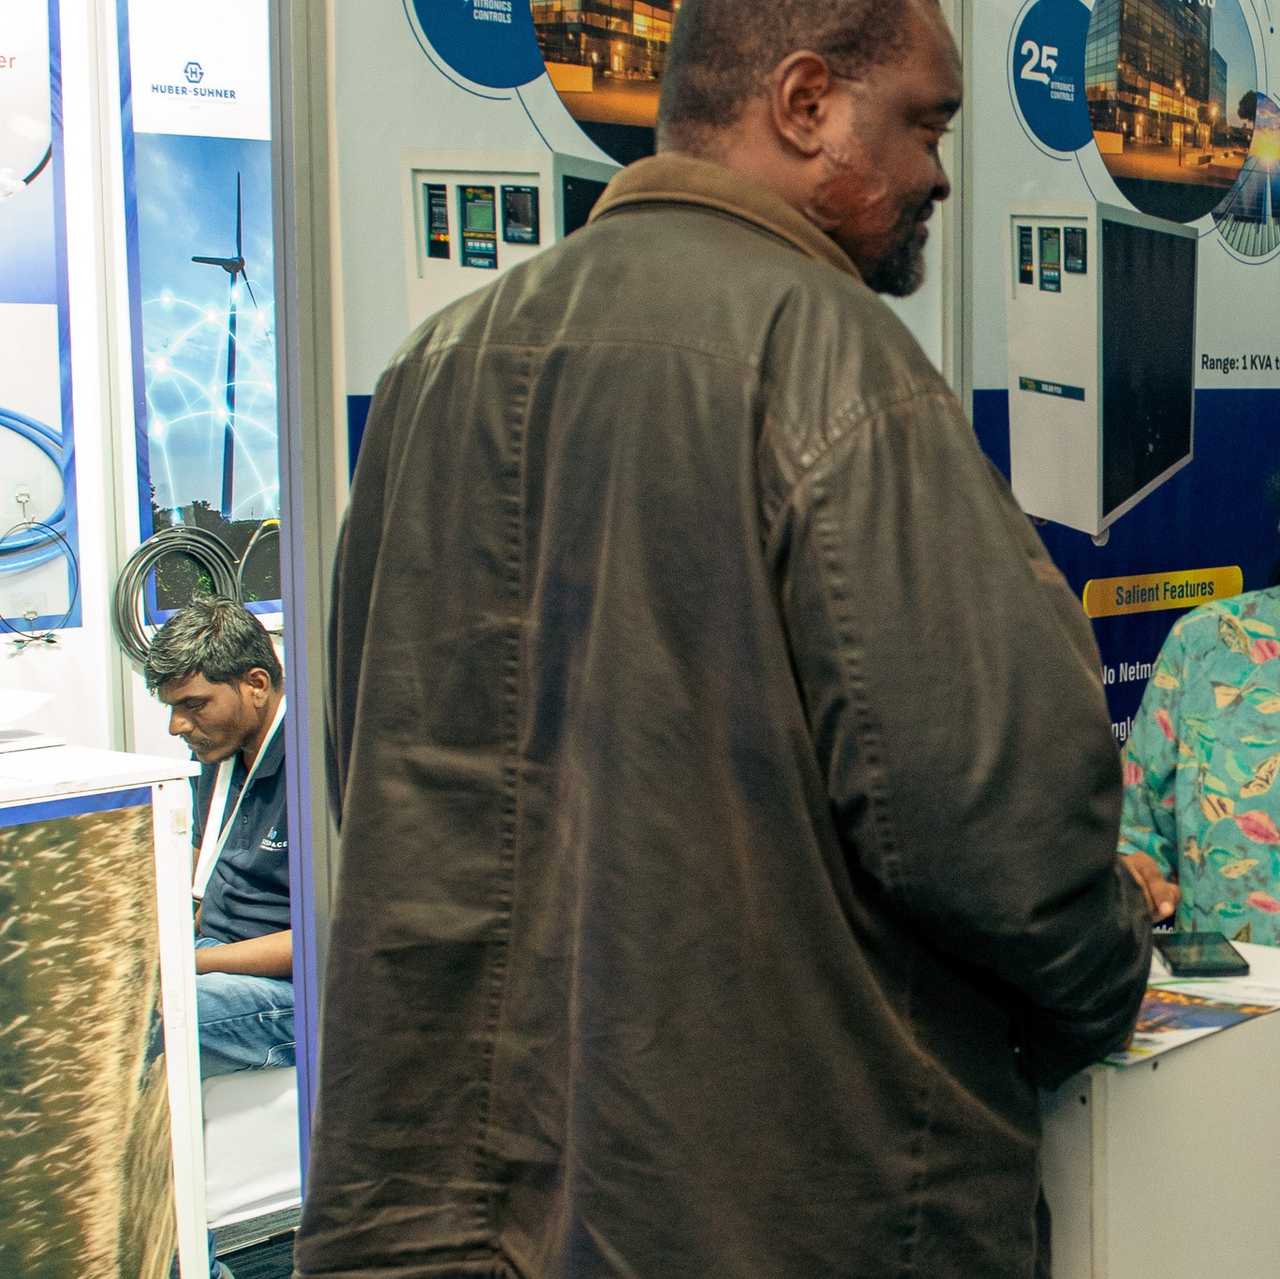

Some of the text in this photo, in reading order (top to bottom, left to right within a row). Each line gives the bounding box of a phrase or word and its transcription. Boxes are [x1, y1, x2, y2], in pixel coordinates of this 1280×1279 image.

[473, 9, 512, 24] CONTROLS
[1021, 40, 1058, 85] 25
[1201, 354, 1239, 374] Range:
[1242, 355, 1248, 370] 1
[1250, 355, 1272, 370] KVA
[1115, 580, 1214, 605] Salient Features
